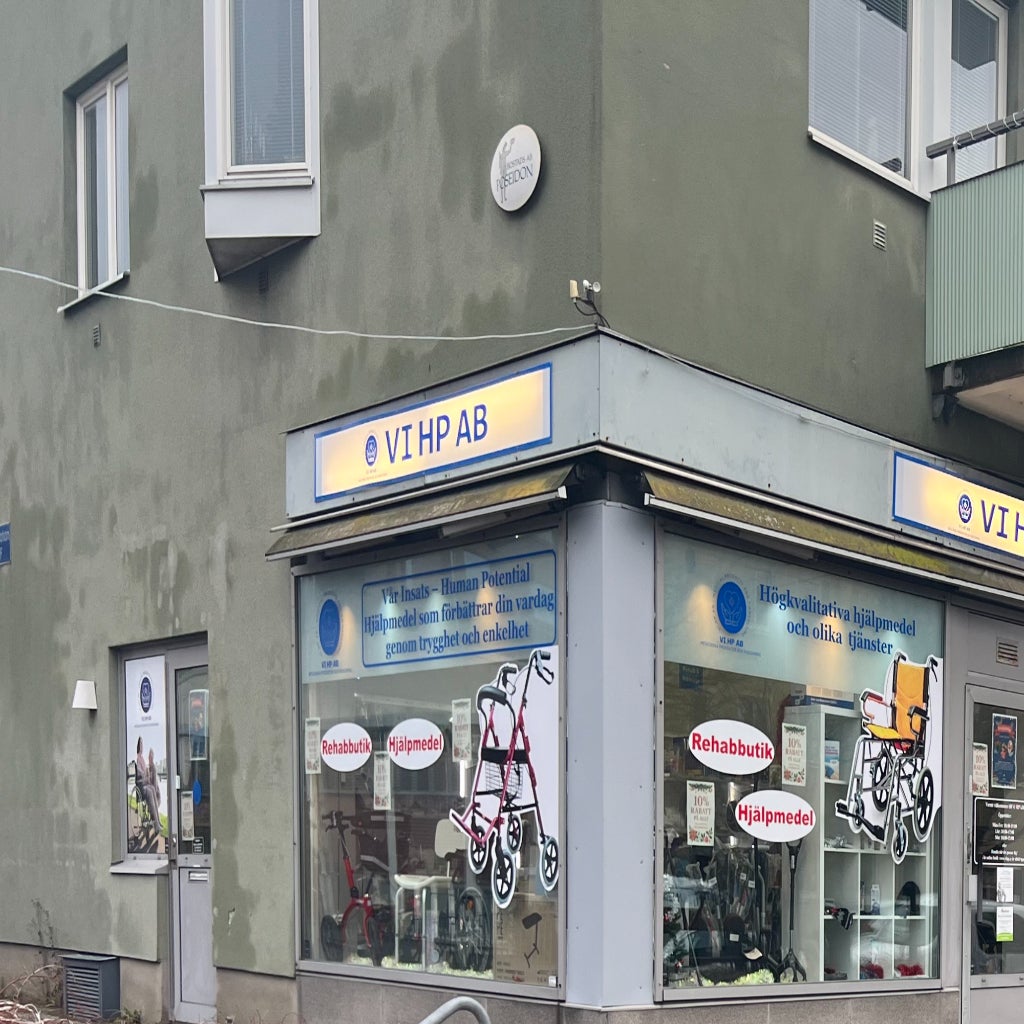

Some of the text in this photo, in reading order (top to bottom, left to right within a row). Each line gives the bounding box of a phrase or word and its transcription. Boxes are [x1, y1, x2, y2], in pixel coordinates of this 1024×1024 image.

[385, 404, 488, 464] VI HP AB
[981, 500, 1009, 539] VI
[381, 586, 399, 605] Vår
[401, 584, 430, 602] Insats
[441, 577, 479, 595] Human
[481, 562, 530, 588] Potential
[364, 588, 555, 637] Hjälpmedel som förbättrar din vardag
[759, 584, 850, 621] Högkvalitativa
[853, 606, 916, 637] hjälpmedel
[385, 620, 529, 659] genom trygghet och enkelhet
[787, 618, 893, 655] och olika tjänster
[322, 738, 371, 755] Rehabbutik
[388, 734, 443, 756] Hjälpmedel
[691, 732, 775, 760] Rehabbutik
[694, 795, 709, 806] 10%
[738, 804, 814, 828] Hjälpmedel
